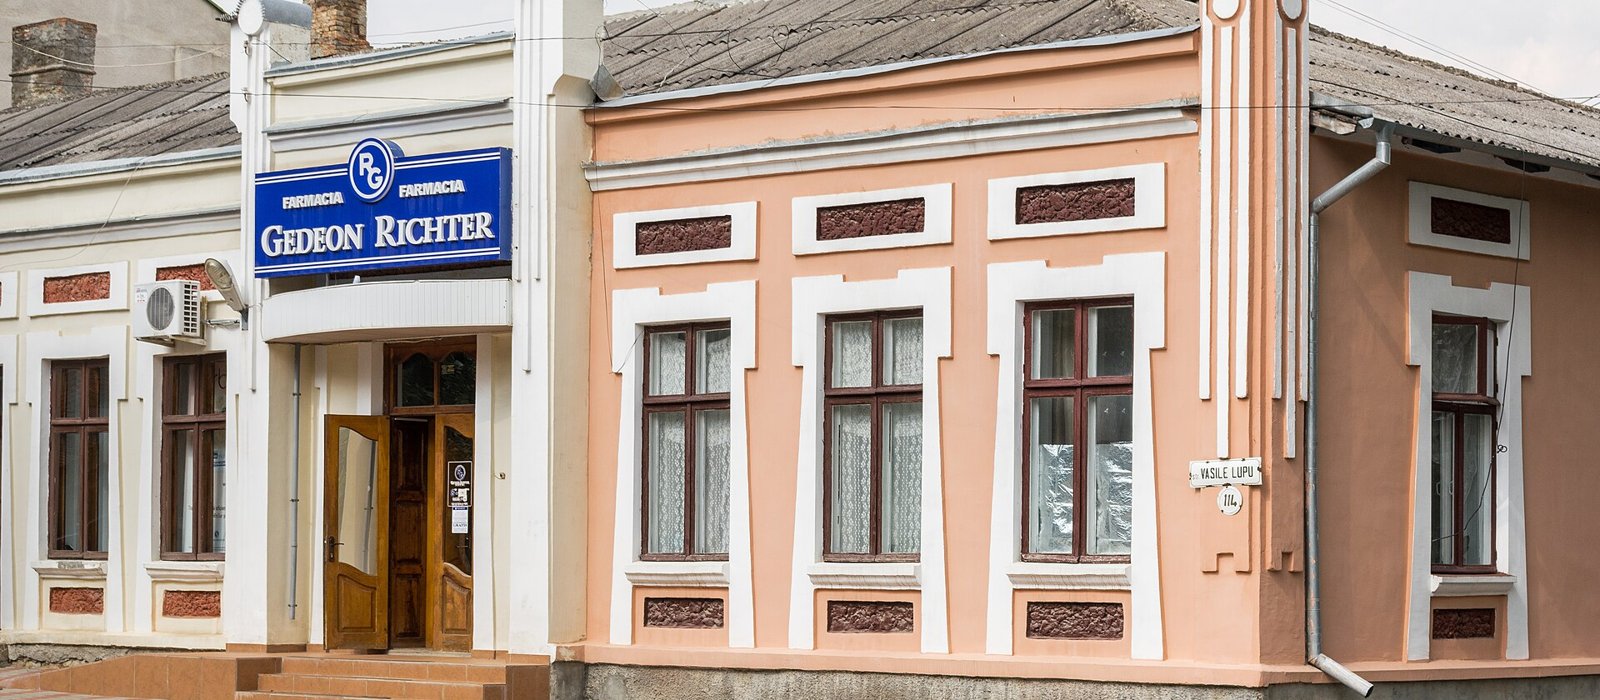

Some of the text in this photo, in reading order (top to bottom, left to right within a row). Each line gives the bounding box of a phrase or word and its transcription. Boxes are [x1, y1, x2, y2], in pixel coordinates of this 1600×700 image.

[359, 152, 384, 190] RG
[282, 179, 466, 210] FARMACIA FARMACIA
[261, 211, 496, 257] GEDEON RICHTER
[1200, 466, 1229, 480] VASILE
[1231, 465, 1254, 479] LUPU
[1223, 493, 1238, 508] 114
